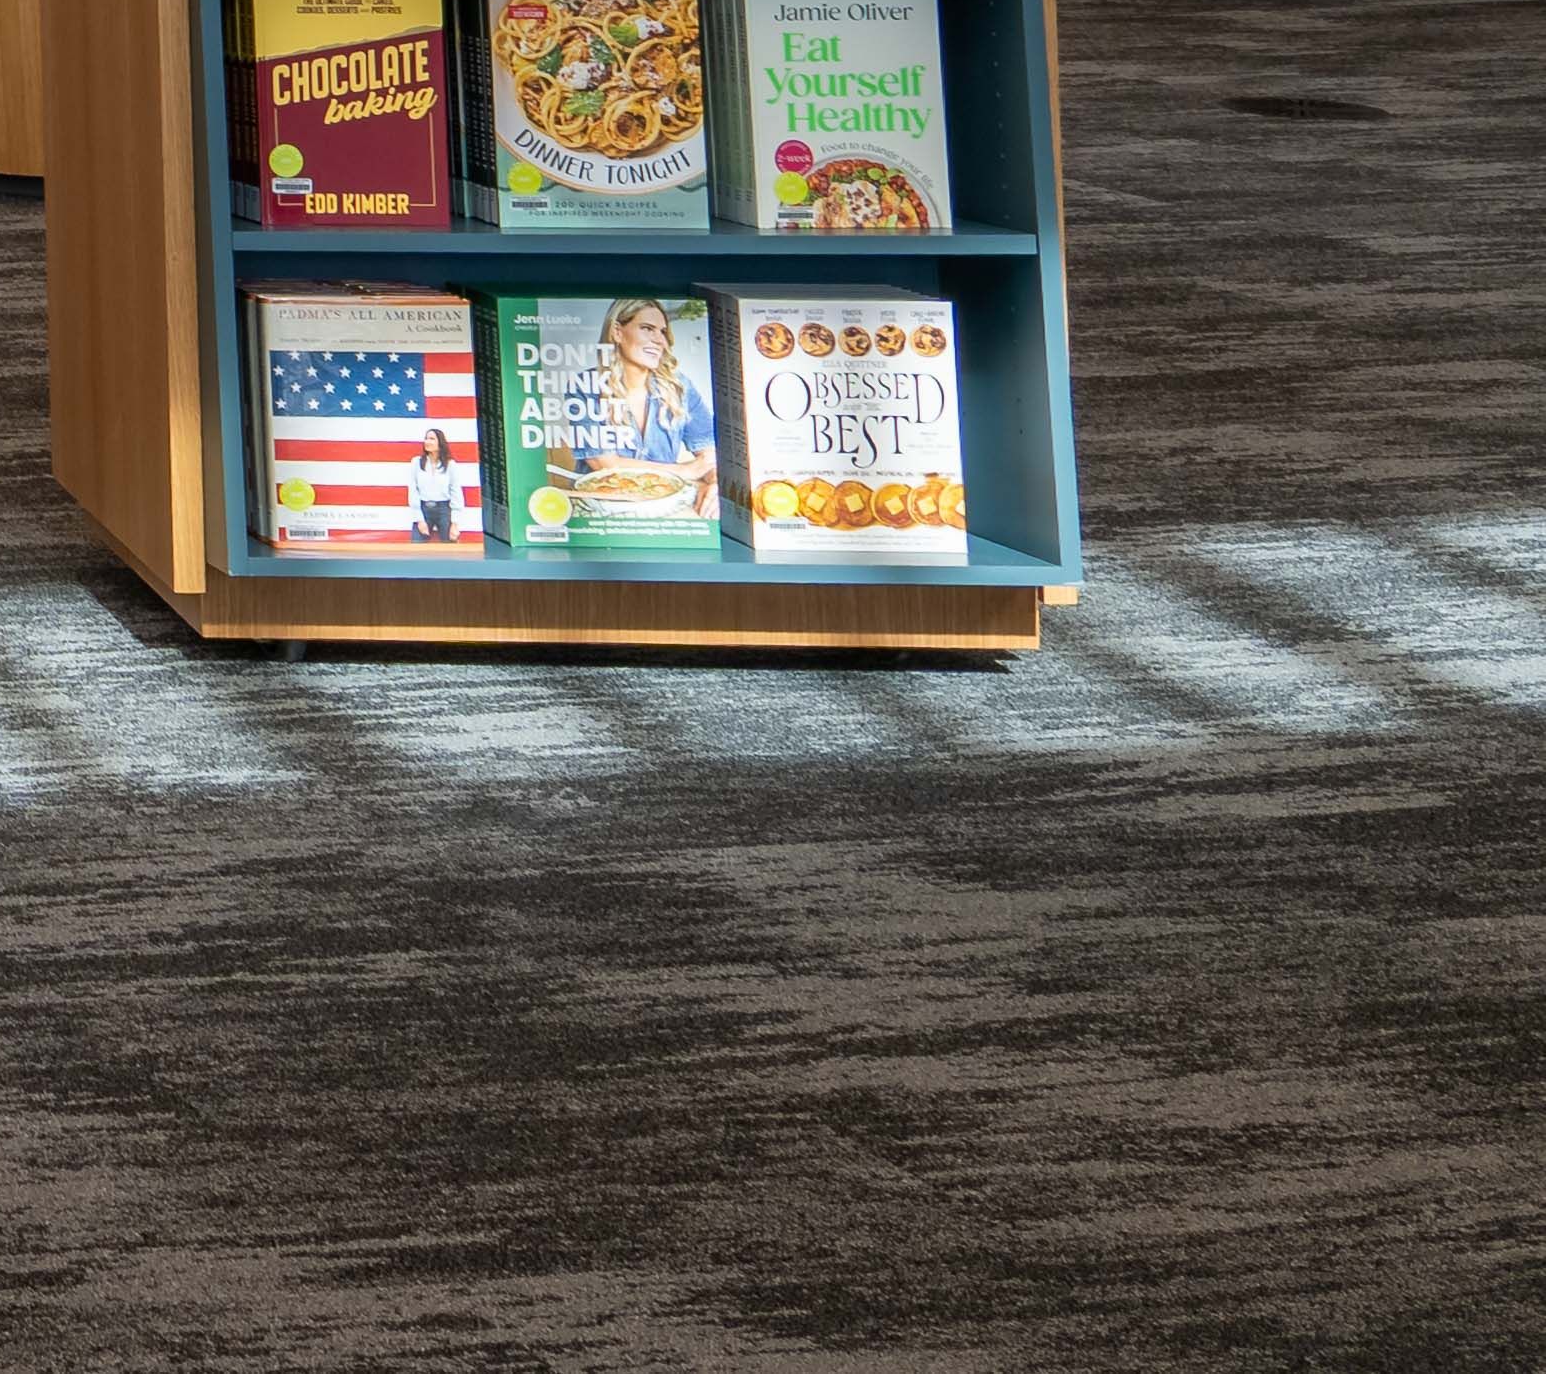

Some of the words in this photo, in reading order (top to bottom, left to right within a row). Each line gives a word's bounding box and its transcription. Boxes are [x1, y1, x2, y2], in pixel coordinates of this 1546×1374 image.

[774, 3, 841, 21] Jamie
[847, 3, 913, 21] Oliver
[782, 32, 842, 62] Eat
[272, 40, 429, 106] CHOCOLATE
[764, 65, 926, 104] Yourself
[324, 86, 438, 124] baking
[787, 103, 932, 139] Healthy
[514, 128, 594, 182] DINNER
[605, 147, 691, 185] TONIGHT
[305, 192, 339, 214] EDD
[343, 192, 410, 214] KIMBER
[278, 309, 341, 320] PADMA'S
[349, 310, 376, 320] ALL
[383, 310, 463, 321] AMERICAN
[517, 343, 614, 366] DON'T
[518, 370, 612, 393] THINK
[520, 398, 626, 421] ABOUT
[765, 371, 945, 423] OBSESSED
[522, 425, 636, 450] DINNER
[811, 415, 911, 469] BEST
